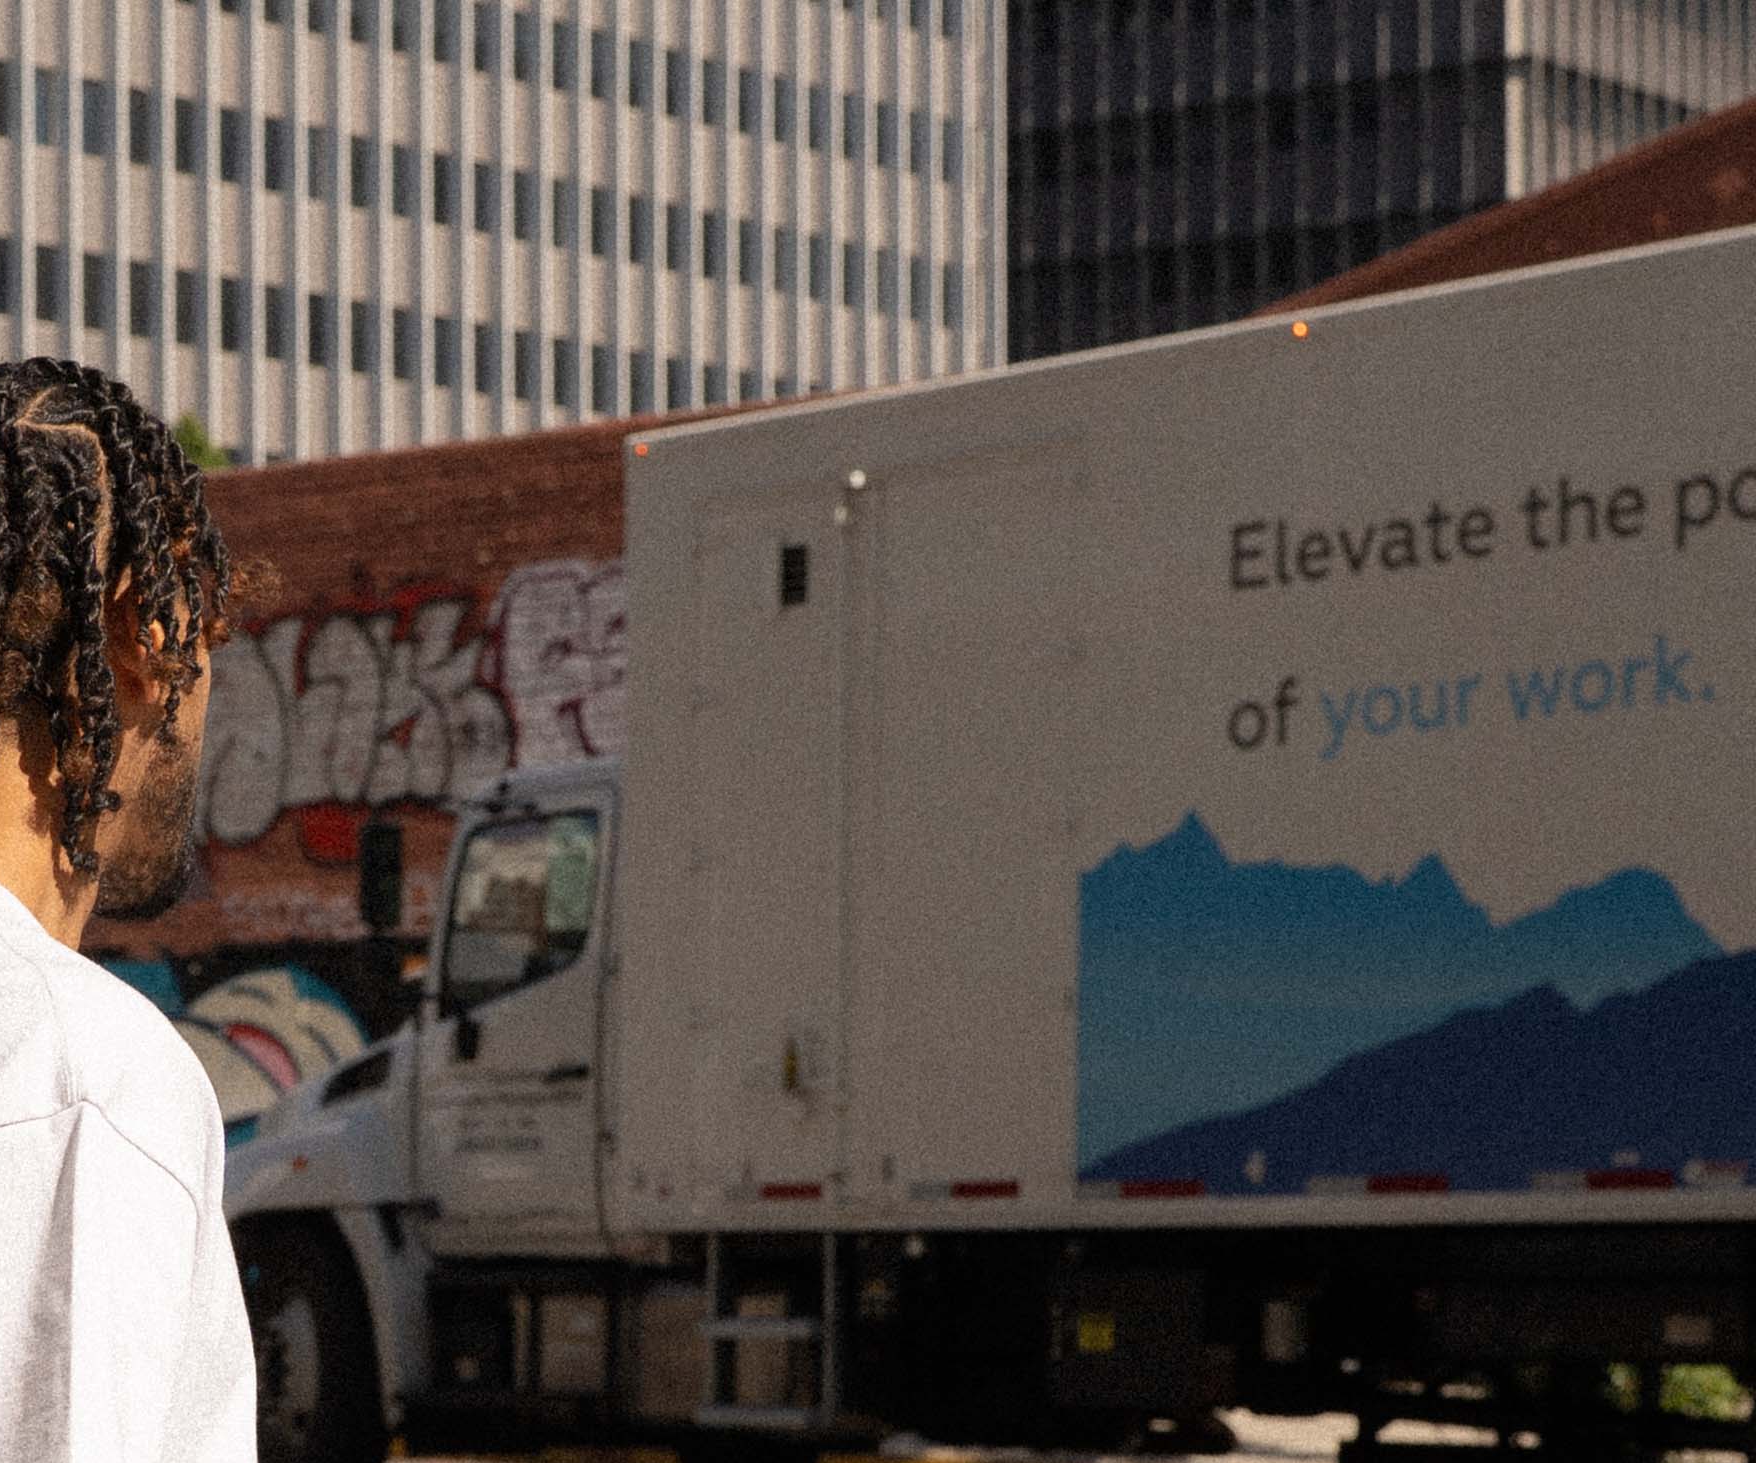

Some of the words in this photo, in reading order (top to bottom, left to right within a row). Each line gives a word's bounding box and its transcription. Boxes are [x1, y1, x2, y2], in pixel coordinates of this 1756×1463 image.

[1228, 503, 1496, 591] Elevate
[1521, 478, 1647, 550] the
[1227, 676, 1299, 751] of
[1320, 673, 1483, 761] your
[1507, 635, 1715, 721] work.
